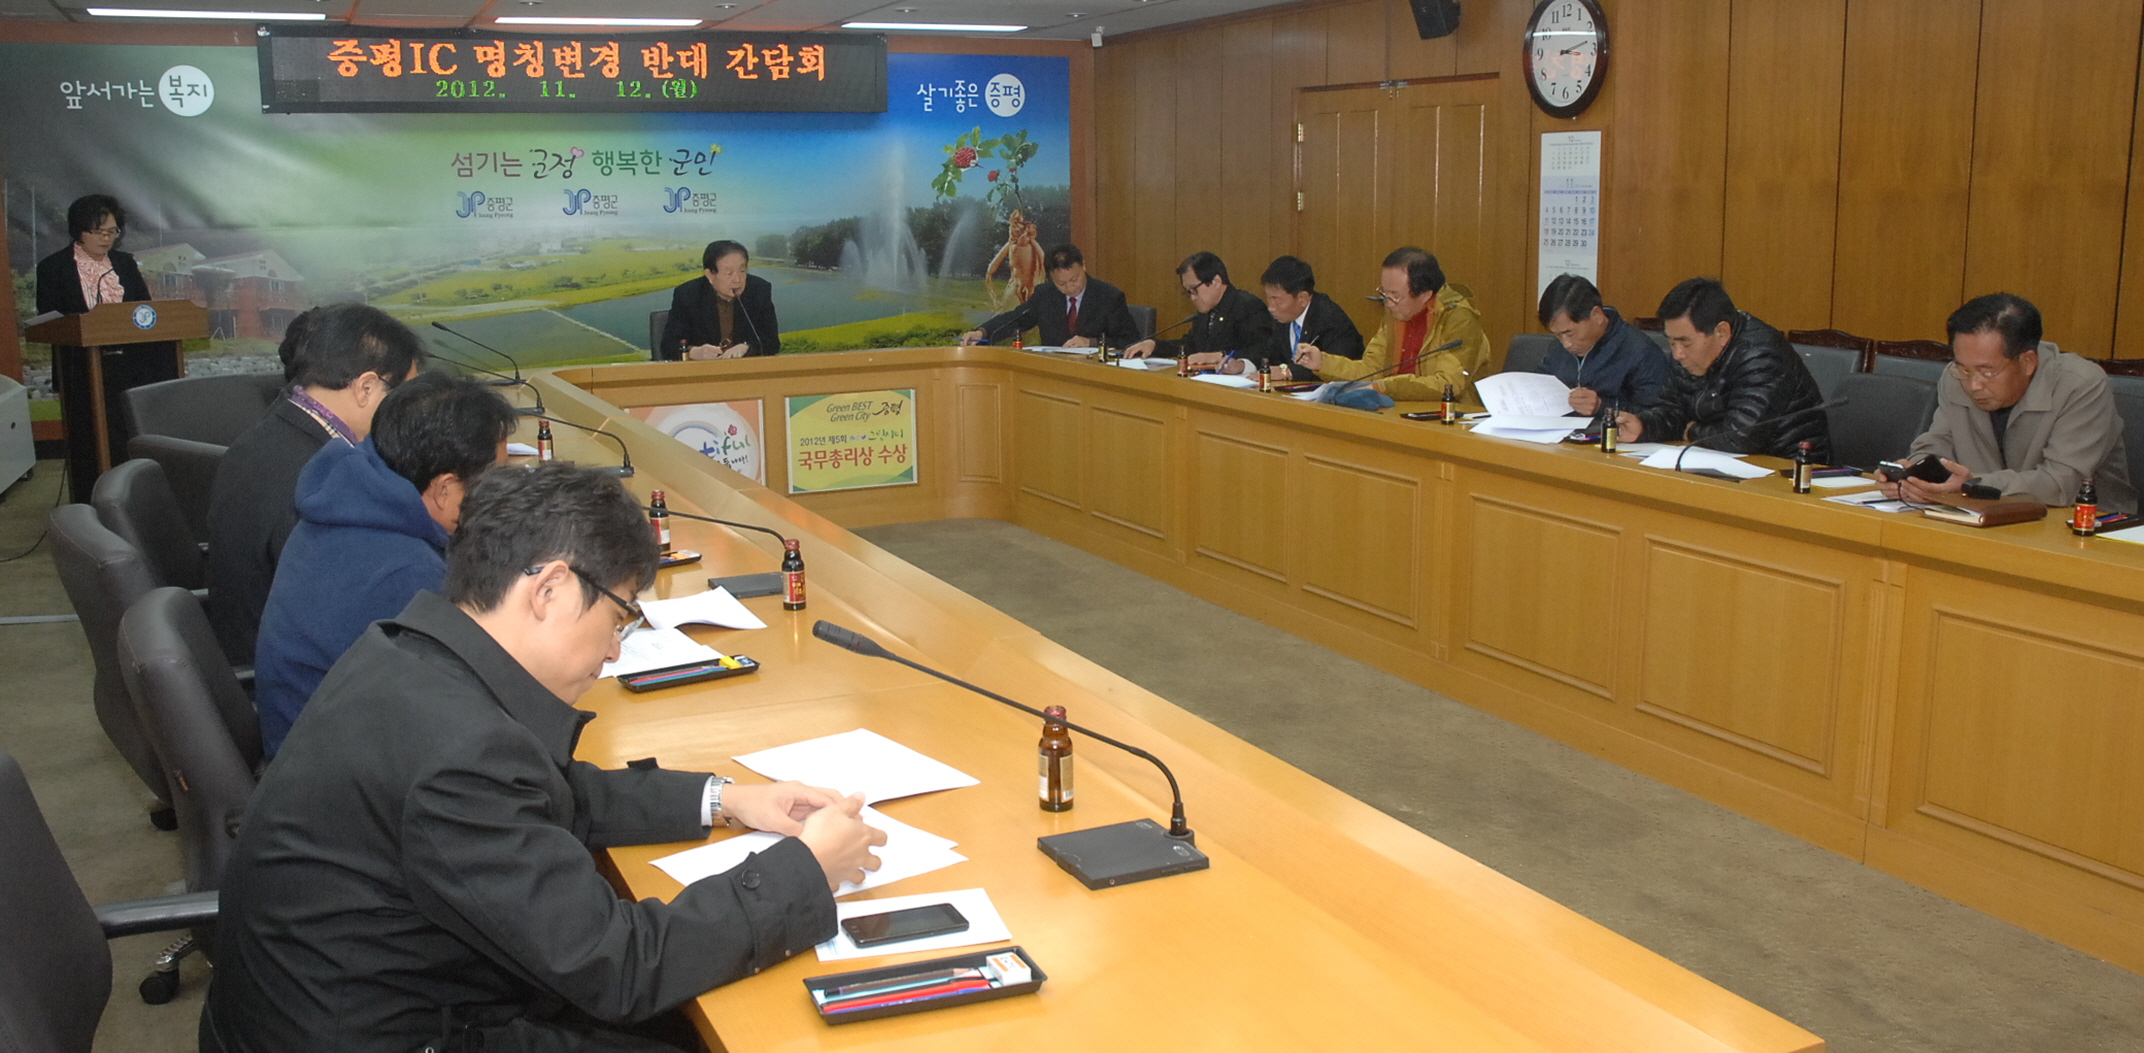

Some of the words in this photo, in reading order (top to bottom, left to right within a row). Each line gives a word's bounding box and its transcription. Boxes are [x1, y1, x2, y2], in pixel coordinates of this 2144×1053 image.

[1551, 11, 1559, 24] 11
[1562, 3, 1572, 18] 12
[1577, 8, 1582, 20] 1
[1542, 27, 1551, 41] 10
[1537, 48, 1544, 60] 9
[1590, 42, 1597, 56] 3
[327, 39, 458, 77] 증평IC
[473, 40, 620, 78] 명칭변경
[641, 41, 708, 79] 반대
[726, 43, 825, 81] 간담회
[1540, 67, 1547, 81] 8
[1585, 64, 1591, 77] 4
[60, 80, 155, 109] 앞서가는
[169, 75, 207, 108] 복지
[435, 80, 506, 98] 2012.
[540, 80, 576, 98] 11.
[1551, 82, 1556, 95] 7
[1562, 86, 1569, 100] 6
[1576, 80, 1582, 93] 5
[917, 80, 979, 113] 살기좋은
[990, 82, 1020, 108] 증평
[451, 152, 523, 178] 섬기는
[529, 149, 577, 179] 군정
[592, 149, 662, 176] 행복한
[487, 197, 513, 211] 증평군
[593, 195, 618, 209] 증평군
[692, 193, 717, 207] 증평군
[826, 404, 850, 413] Green
[851, 401, 873, 411] BEST
[830, 413, 853, 422] Green
[855, 412, 872, 422] City
[800, 436, 826, 446] 2012년
[798, 447, 874, 471] 국무총리상
[878, 444, 908, 464] 수상
